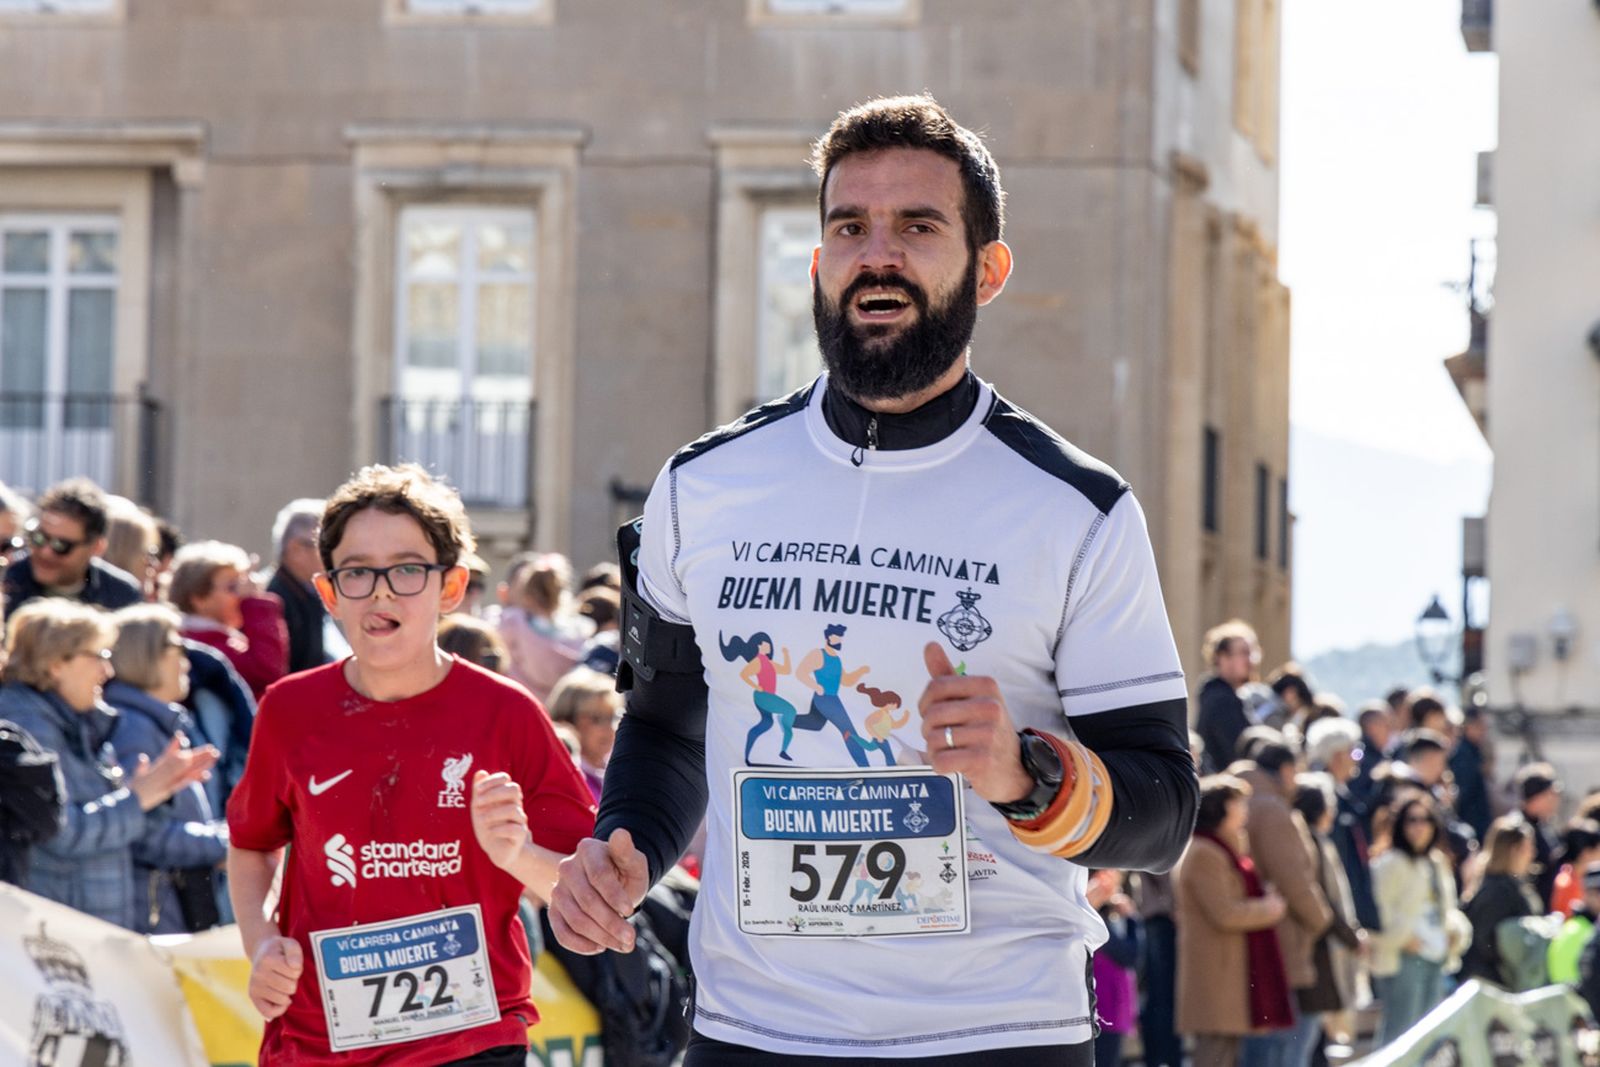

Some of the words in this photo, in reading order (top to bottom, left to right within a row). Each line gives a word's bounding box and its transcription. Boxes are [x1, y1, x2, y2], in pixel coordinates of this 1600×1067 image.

[732, 540, 752, 562] VI
[756, 541, 861, 566] CARRERA
[871, 547, 1000, 585] CAMINATA
[717, 576, 802, 610] BUENA
[813, 578, 936, 624] MUERTE
[763, 786, 776, 800] VI
[779, 785, 844, 800] CARRERA
[848, 783, 929, 799] CAMINATA
[764, 808, 817, 832] BUENA
[821, 808, 894, 833] MUERTE
[360, 839, 461, 861] standard
[361, 855, 462, 879] chartered
[790, 841, 906, 902] 579
[798, 902, 819, 912] RAÚL
[821, 903, 854, 913] MUÑOZ
[856, 901, 902, 912] MARTÍNEZ
[336, 940, 349, 951] VI
[350, 932, 401, 950] CARRERA
[402, 919, 460, 942] CAMINATA
[339, 952, 383, 974] BUENA
[384, 942, 439, 967] MUERTE
[362, 965, 454, 1018] 722
